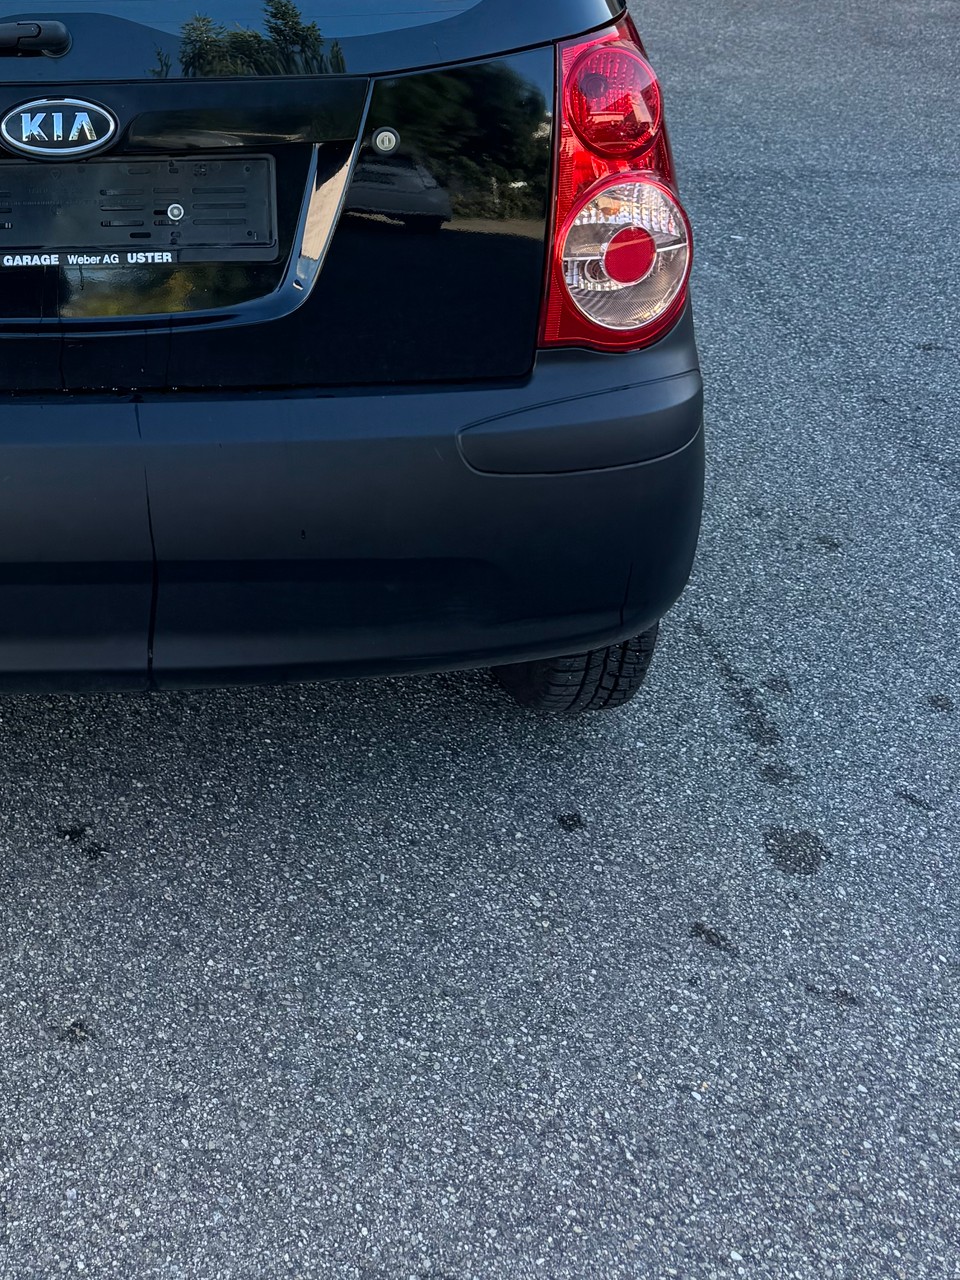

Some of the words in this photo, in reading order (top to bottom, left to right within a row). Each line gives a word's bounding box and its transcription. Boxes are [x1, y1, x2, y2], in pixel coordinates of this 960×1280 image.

[20, 112, 98, 142] KIA
[3, 254, 60, 266] GARAGE
[67, 254, 102, 265] Weber
[103, 254, 120, 264] AG
[127, 252, 173, 264] USTER
